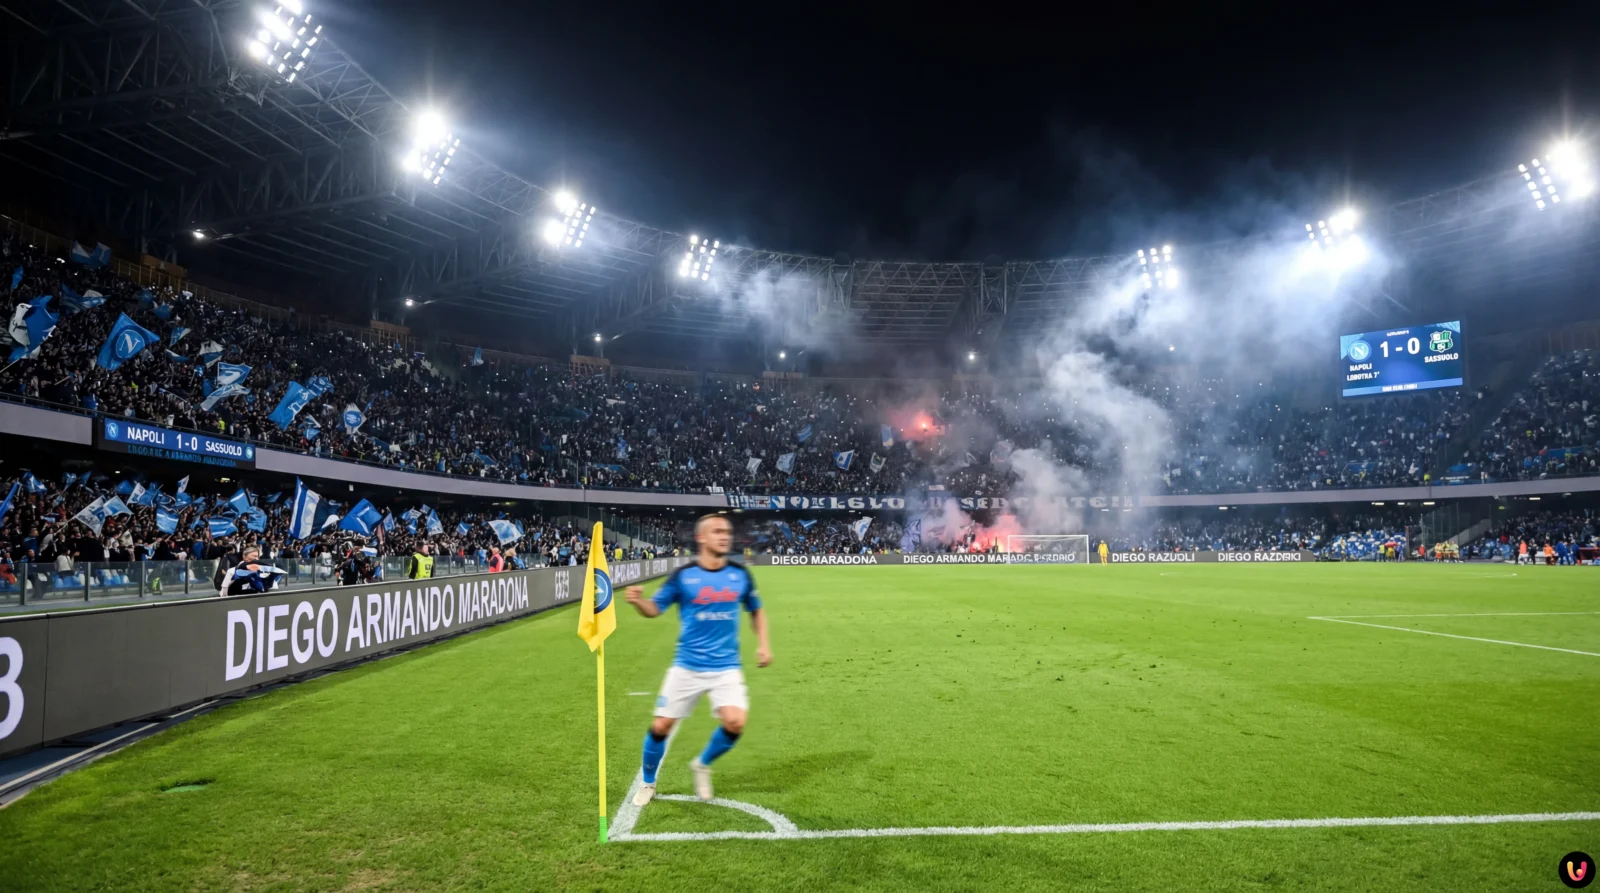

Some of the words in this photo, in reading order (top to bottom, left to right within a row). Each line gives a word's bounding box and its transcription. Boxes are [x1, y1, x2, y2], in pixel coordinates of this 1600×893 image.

[1380, 341, 1389, 358] 1
[1407, 337, 1420, 355] 0
[1424, 353, 1459, 363] SASSUOLO
[1349, 363, 1372, 372] NAPOLI
[127, 426, 165, 445] NAPOLI
[205, 440, 242, 457] SASSUOLO
[771, 555, 809, 565] DIEGO
[811, 555, 877, 565] MARADONA
[903, 554, 934, 564] DIEGO
[936, 554, 985, 563] ARMANDO
[1112, 553, 1146, 562] DIEGO
[1218, 552, 1251, 562] DIEGO
[225, 599, 339, 682] DIEGO
[345, 585, 454, 653] ARMANDO
[458, 575, 530, 624] MARADONA
